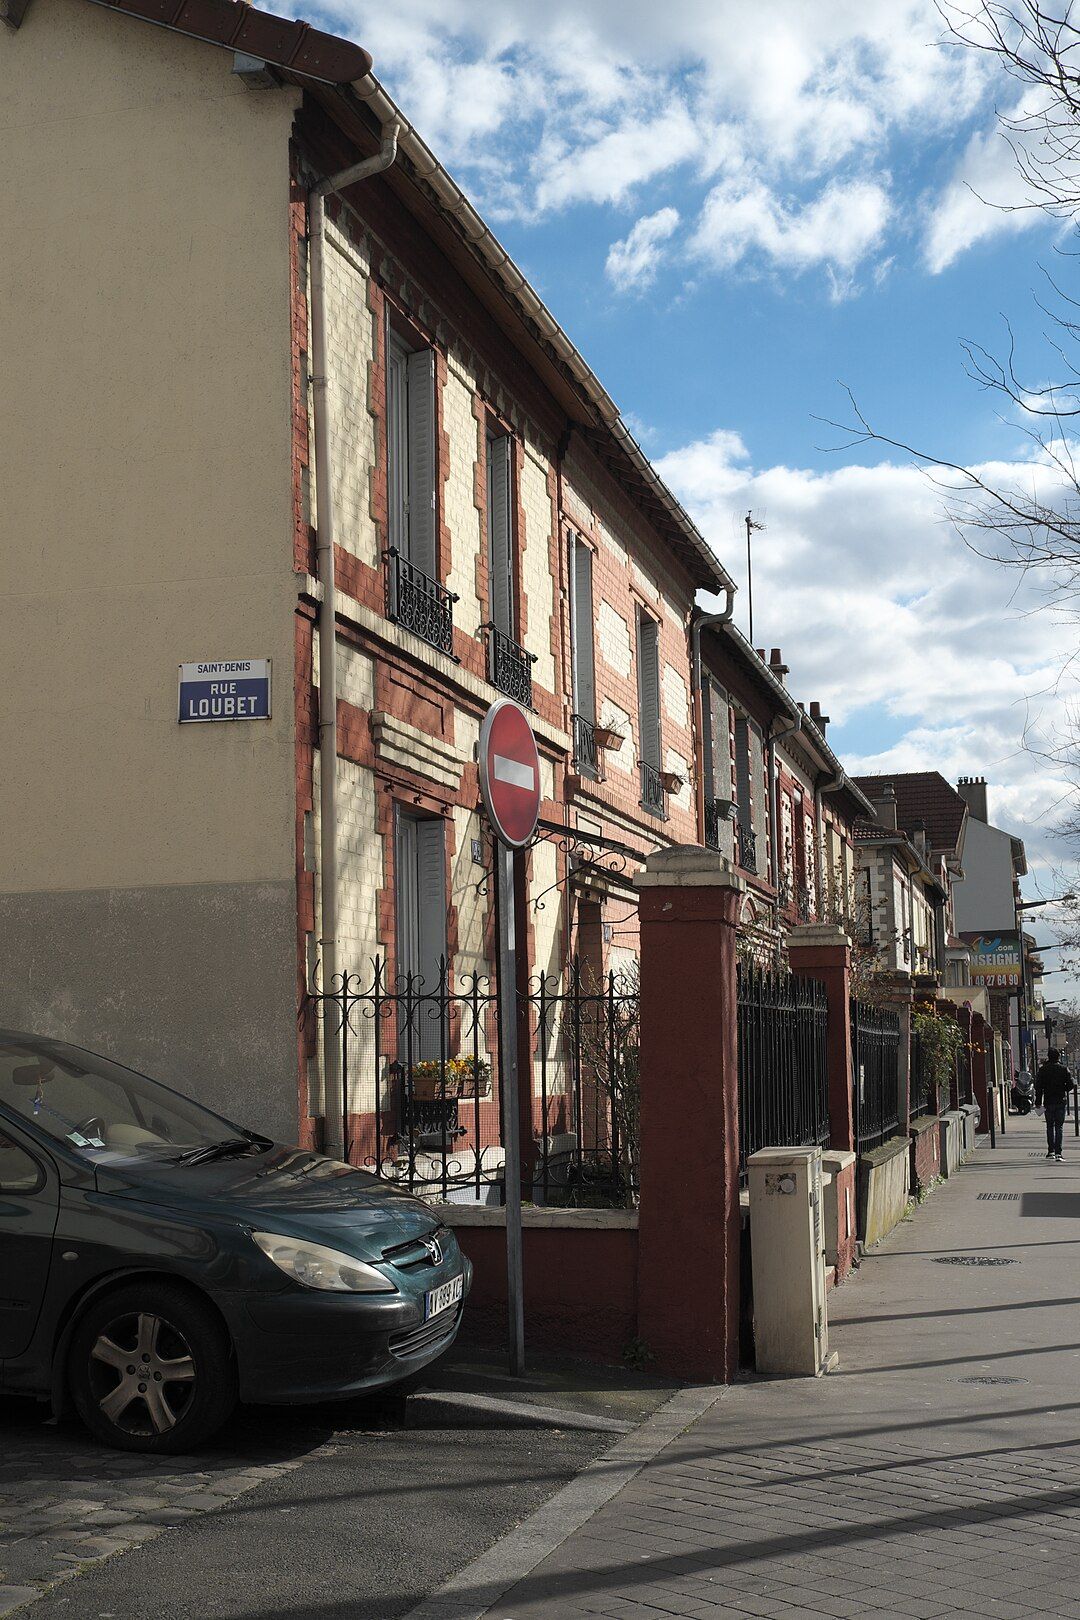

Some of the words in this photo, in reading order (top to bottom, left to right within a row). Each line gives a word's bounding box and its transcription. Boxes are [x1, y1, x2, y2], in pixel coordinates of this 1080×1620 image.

[197, 662, 251, 673] SAINT-DENIS
[210, 683, 237, 695] RUE
[189, 696, 258, 717] LOUBET
[975, 975, 985, 986] 48
[986, 974, 996, 986] 27
[997, 974, 1007, 986] 64
[1008, 973, 1019, 985] 90
